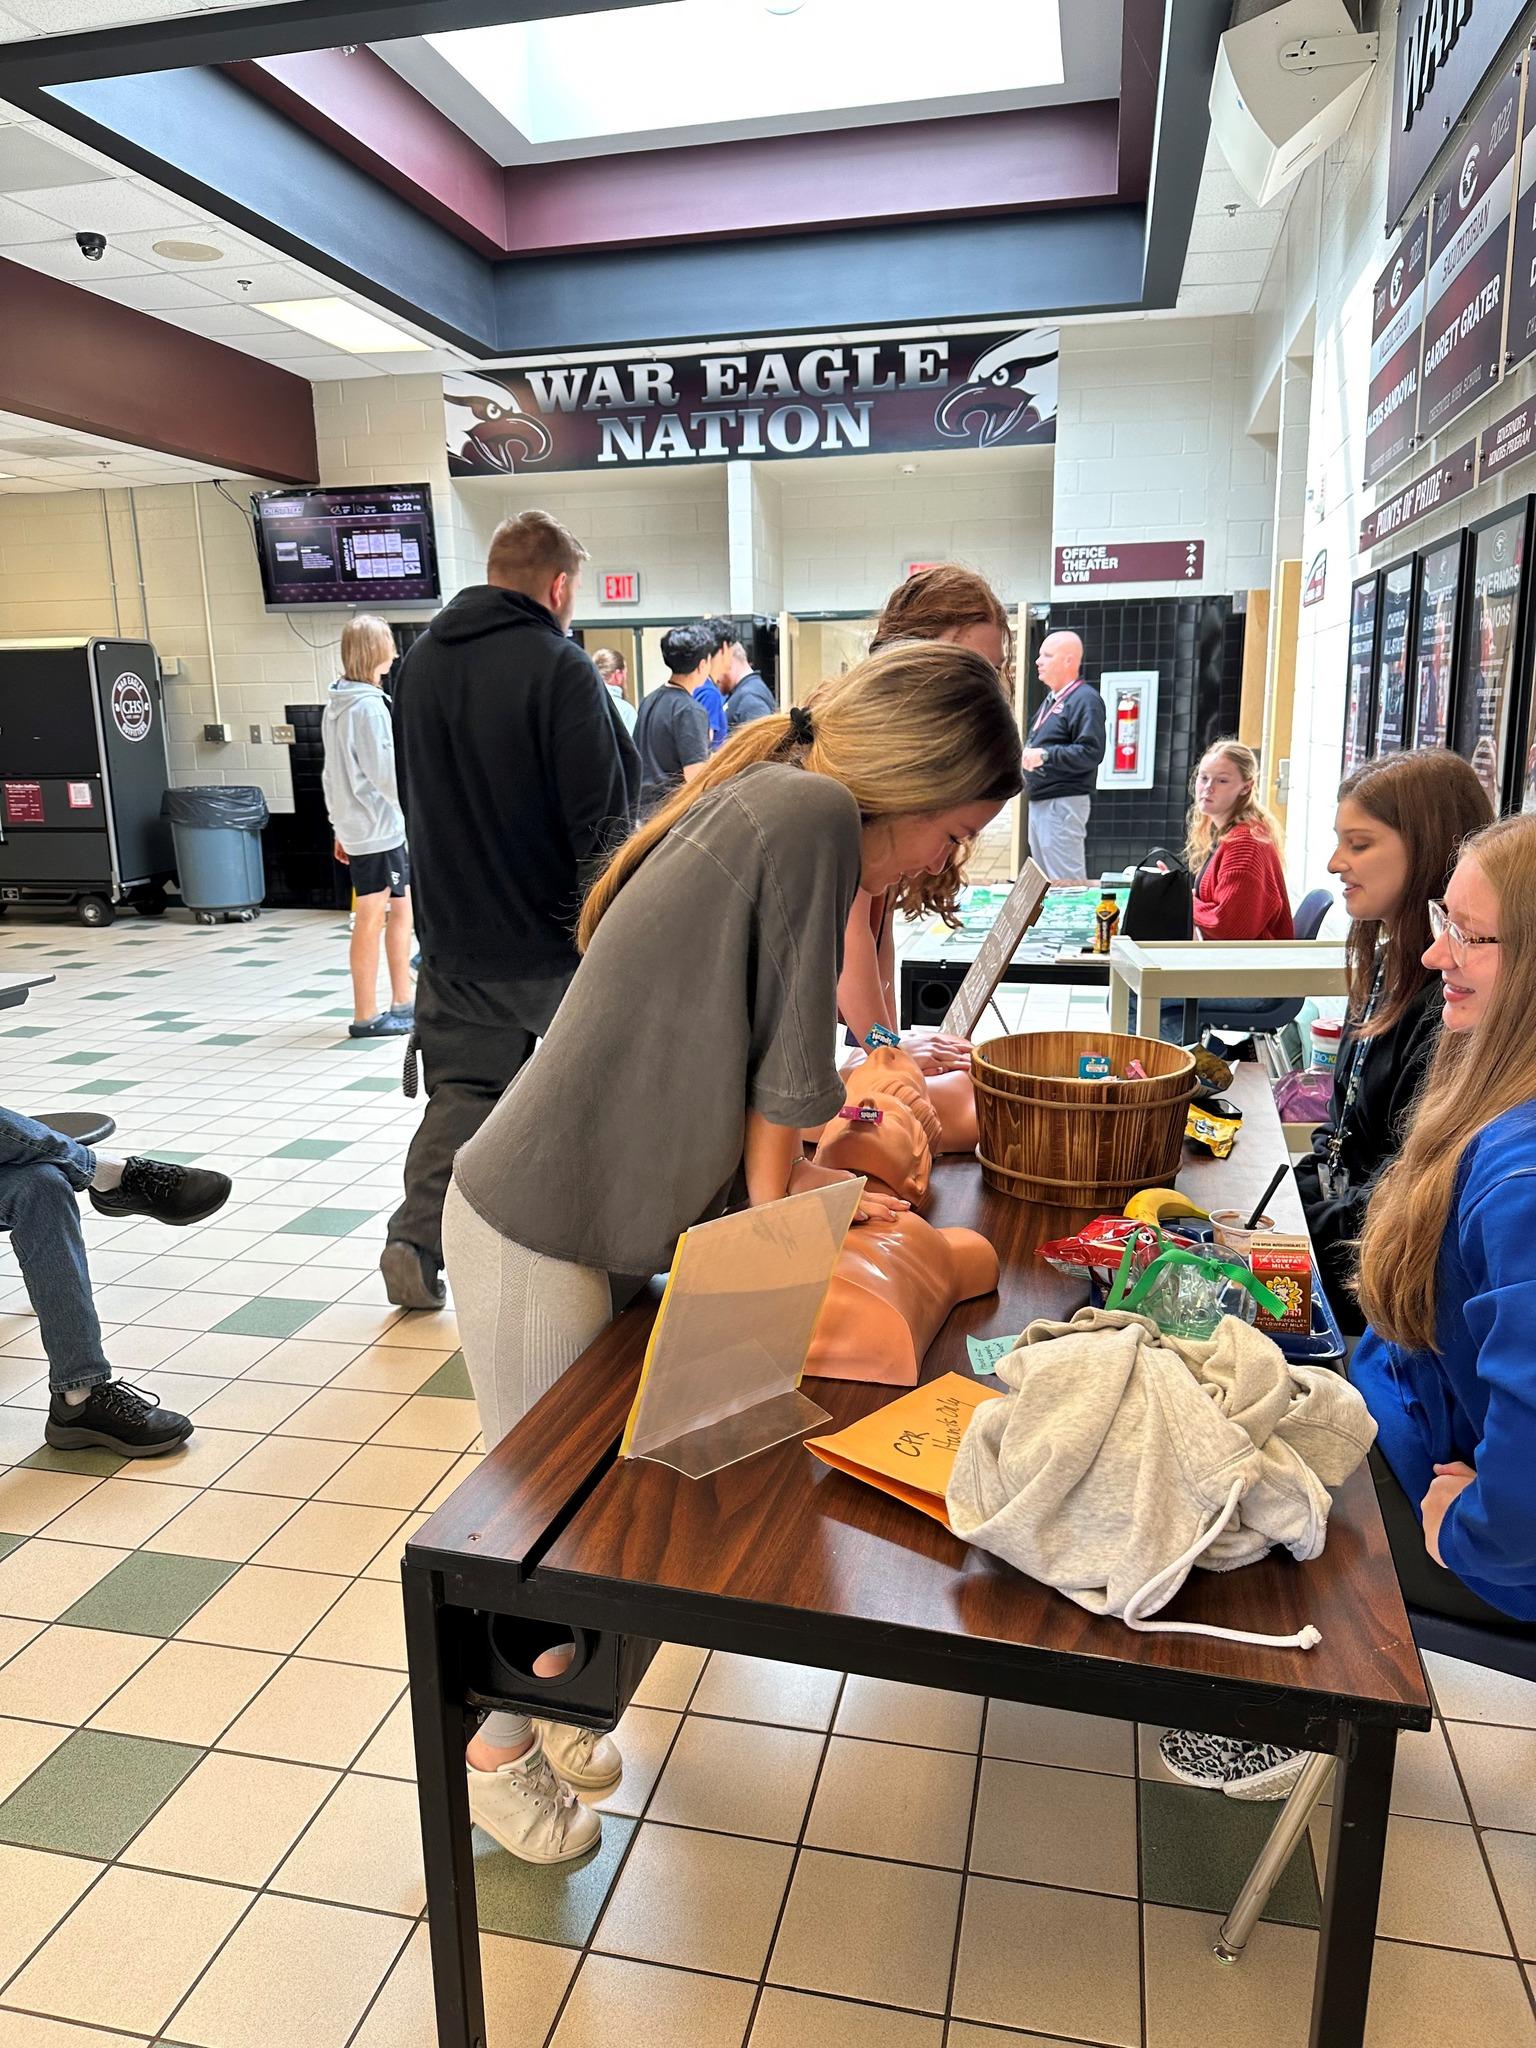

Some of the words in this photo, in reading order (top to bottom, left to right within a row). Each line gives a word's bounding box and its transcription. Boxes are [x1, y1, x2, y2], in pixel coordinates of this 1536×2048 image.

[1488, 97, 1512, 156] 2022
[1425, 316, 1460, 377] GARRETT
[1461, 274, 1500, 338] GRATER
[524, 362, 680, 414] WAR
[700, 341, 950, 403] EAGLE
[1384, 368, 1416, 419] SANDOVAL
[596, 401, 873, 462] NATION
[392, 503, 412, 511] 12:22
[1376, 497, 1402, 538] POINTS
[1402, 490, 1414, 520] OF
[1414, 469, 1443, 514] PRIDE
[1061, 546, 1107, 560] OFFICE
[1062, 557, 1119, 571] THEATER
[605, 575, 633, 600] EXIT
[1061, 571, 1090, 583] GYM
[1475, 564, 1520, 599] GOVERNORS
[122, 700, 142, 714] CHS
[893, 1430, 930, 1457] CPR
